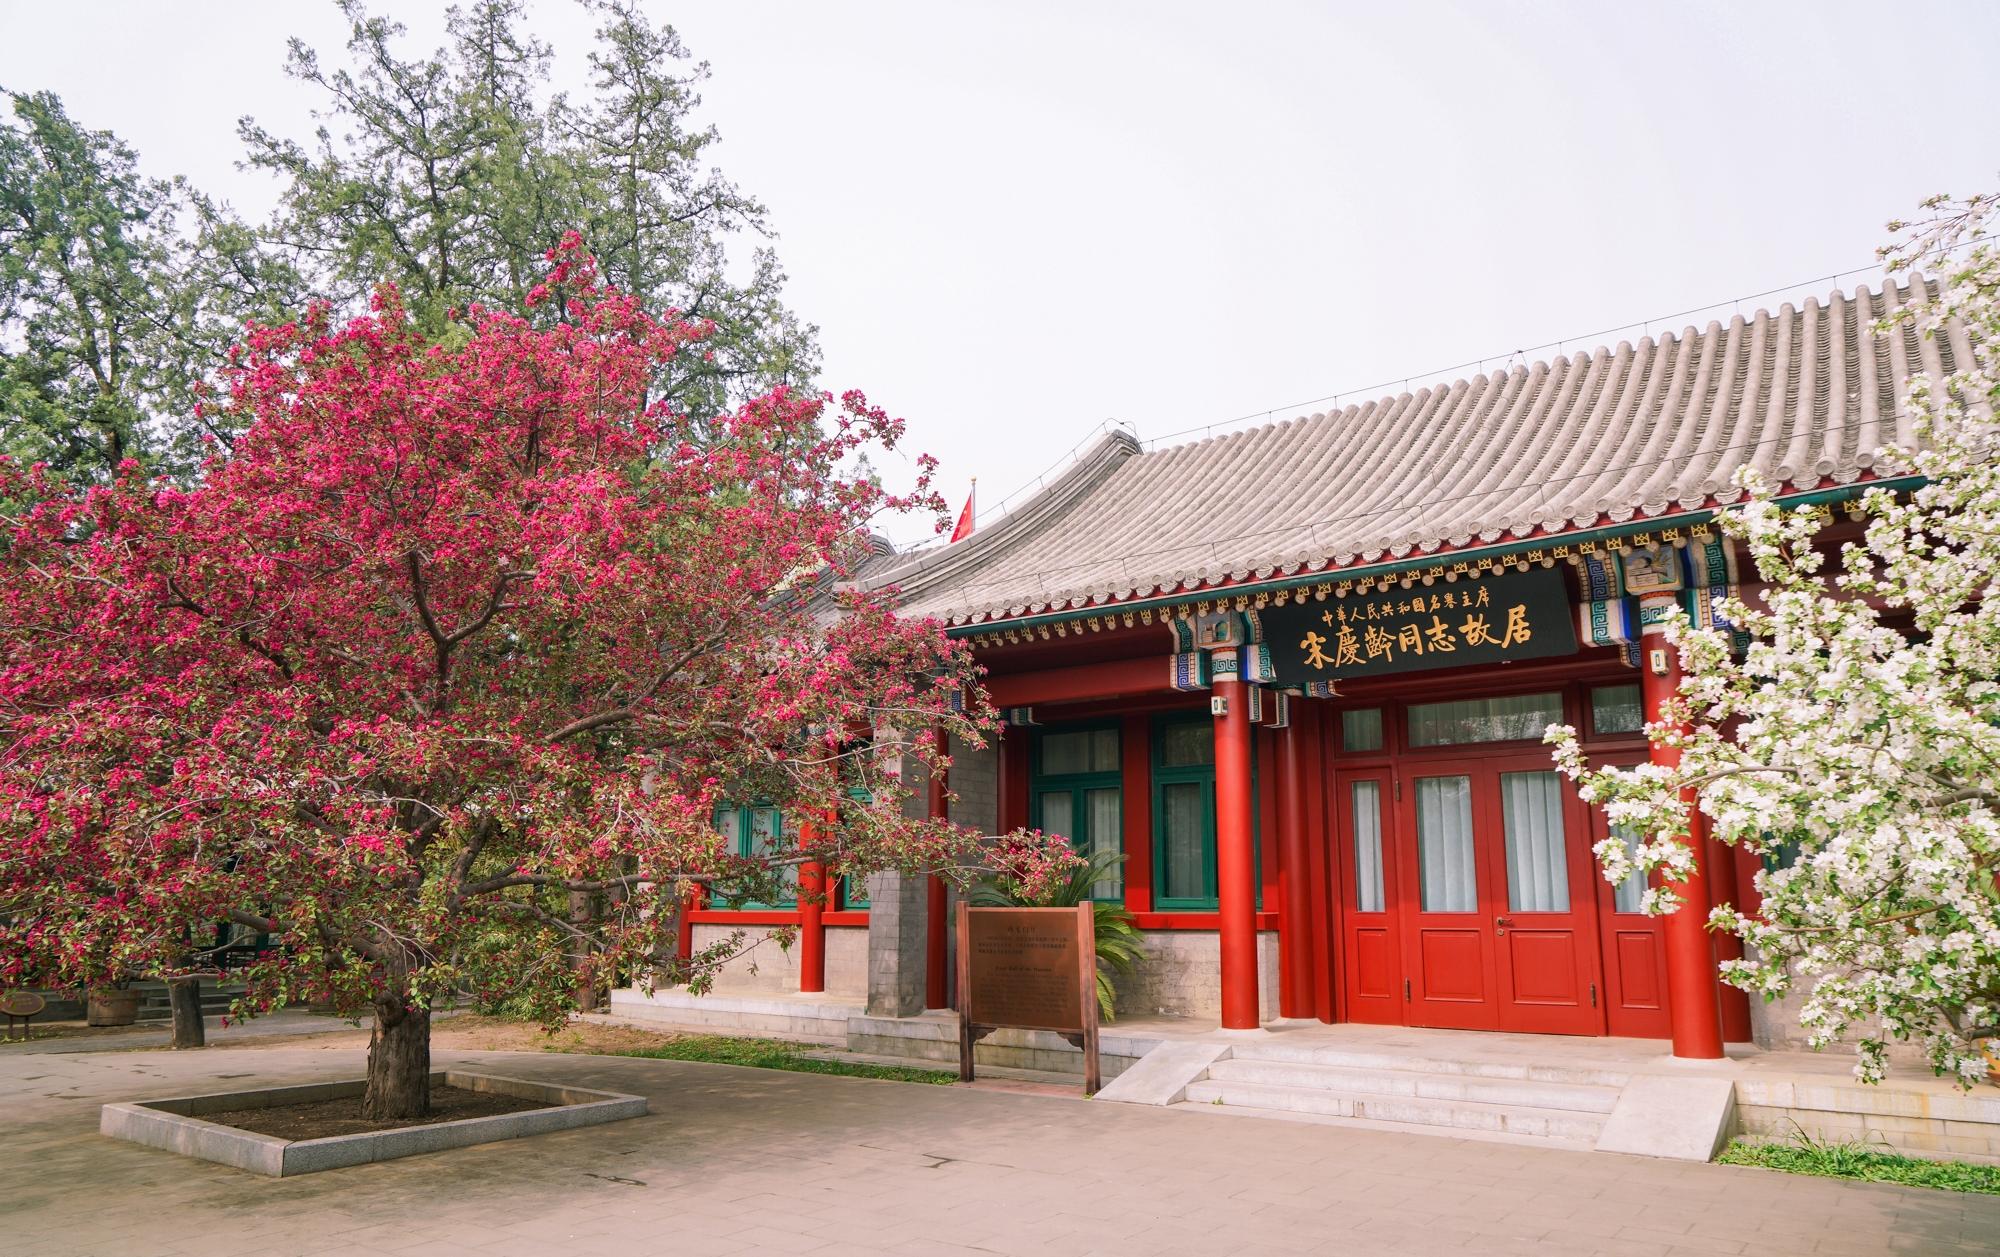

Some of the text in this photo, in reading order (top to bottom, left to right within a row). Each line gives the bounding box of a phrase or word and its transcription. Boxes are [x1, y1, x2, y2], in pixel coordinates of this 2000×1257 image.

[1299, 604, 1532, 669] 宋慶齡同志故居
